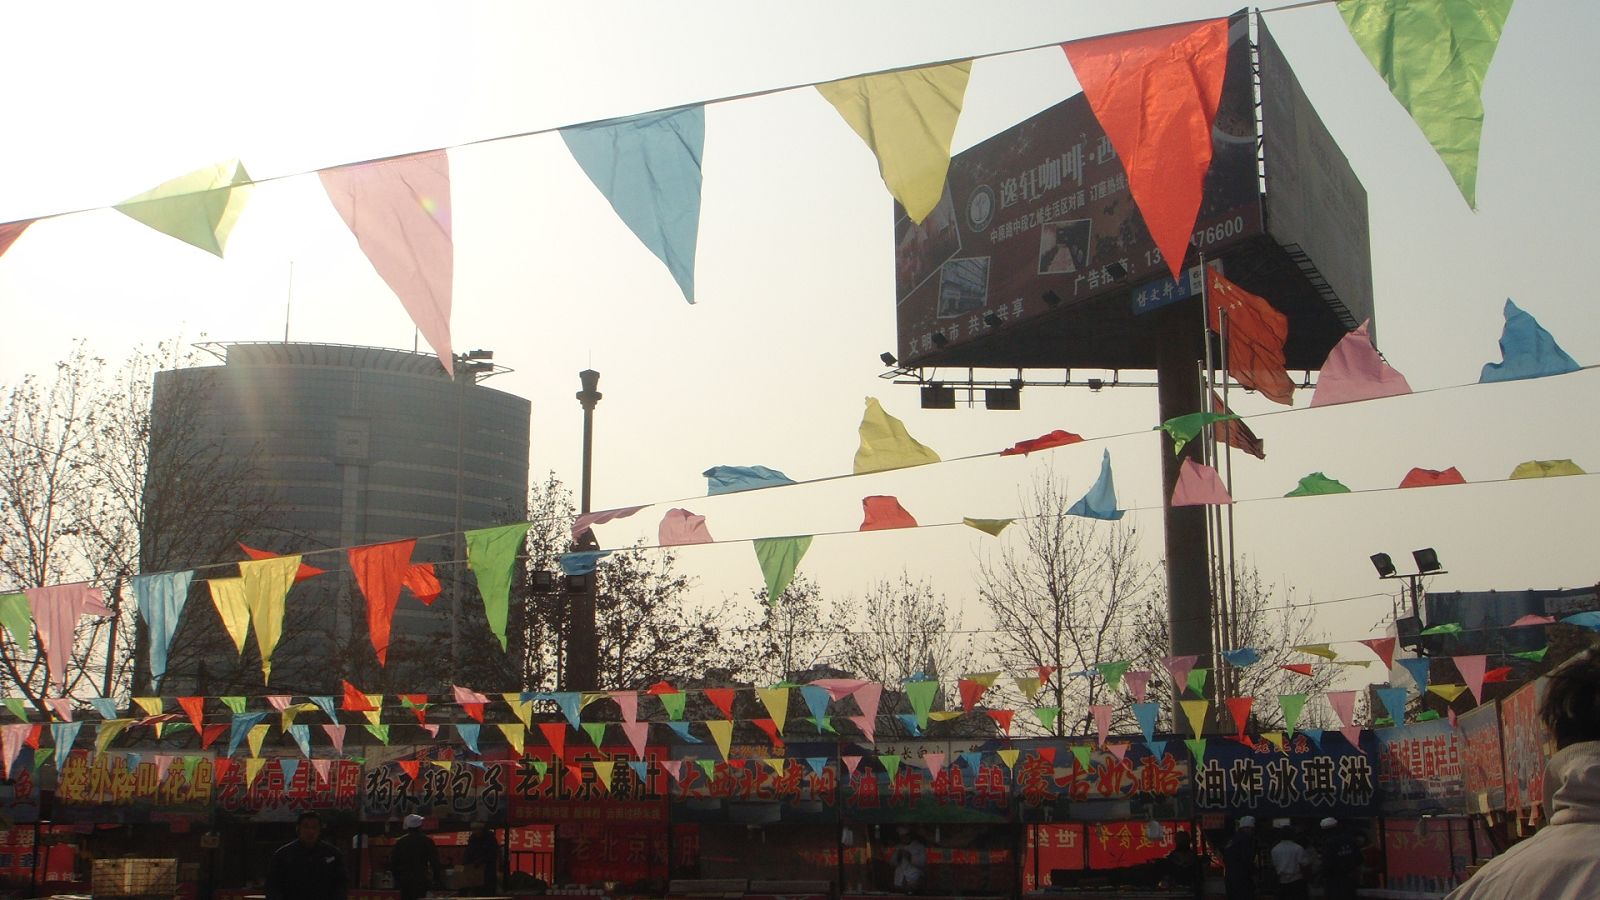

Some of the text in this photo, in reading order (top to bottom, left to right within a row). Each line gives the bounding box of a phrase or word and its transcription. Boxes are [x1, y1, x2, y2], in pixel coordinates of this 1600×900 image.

[60, 756, 213, 807] 楼外楼叫花鸡
[218, 757, 361, 811] 老北京臭豆腐
[366, 761, 504, 813] 狗不理包子
[515, 752, 662, 801] 老北京爆肚
[847, 763, 1008, 809] 油炸鹌鹑
[1016, 752, 1184, 808] 蒙古奶酪
[1195, 756, 1373, 808] 油炸冰琪淋
